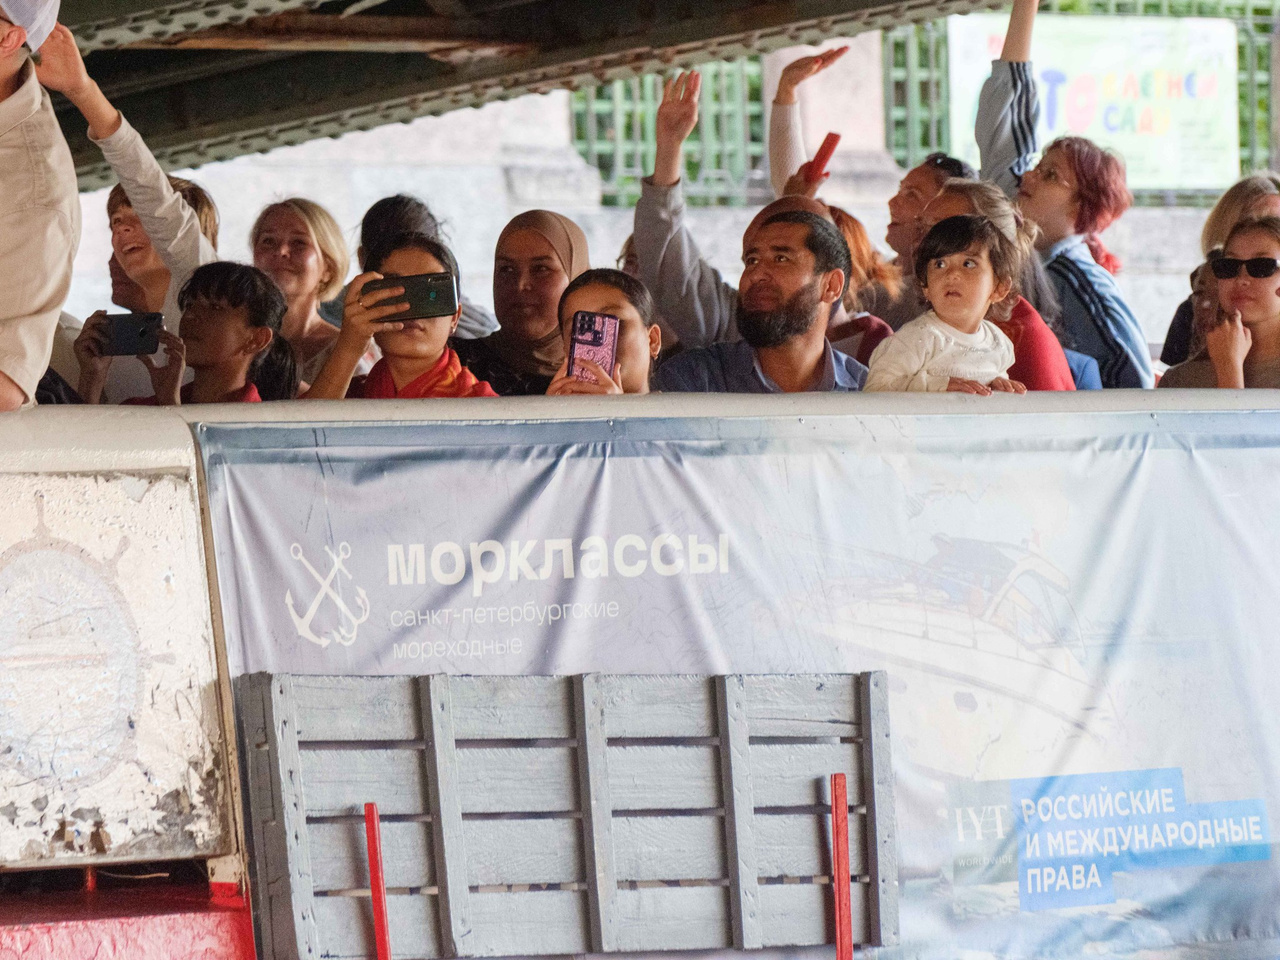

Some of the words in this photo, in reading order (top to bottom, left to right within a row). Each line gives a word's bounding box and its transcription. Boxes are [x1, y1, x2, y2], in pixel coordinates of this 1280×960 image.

[387, 532, 729, 597] морклассы
[391, 601, 620, 627] санкт-петербургские
[393, 639, 523, 659] мореходные
[954, 804, 1008, 841] IYT
[1021, 786, 1175, 823] РОССИЙСКИЕ
[1025, 832, 1040, 858] И
[1047, 815, 1263, 857] МЕЖДУНАРОДНЫЕ
[1026, 862, 1102, 894] ПРАВА
